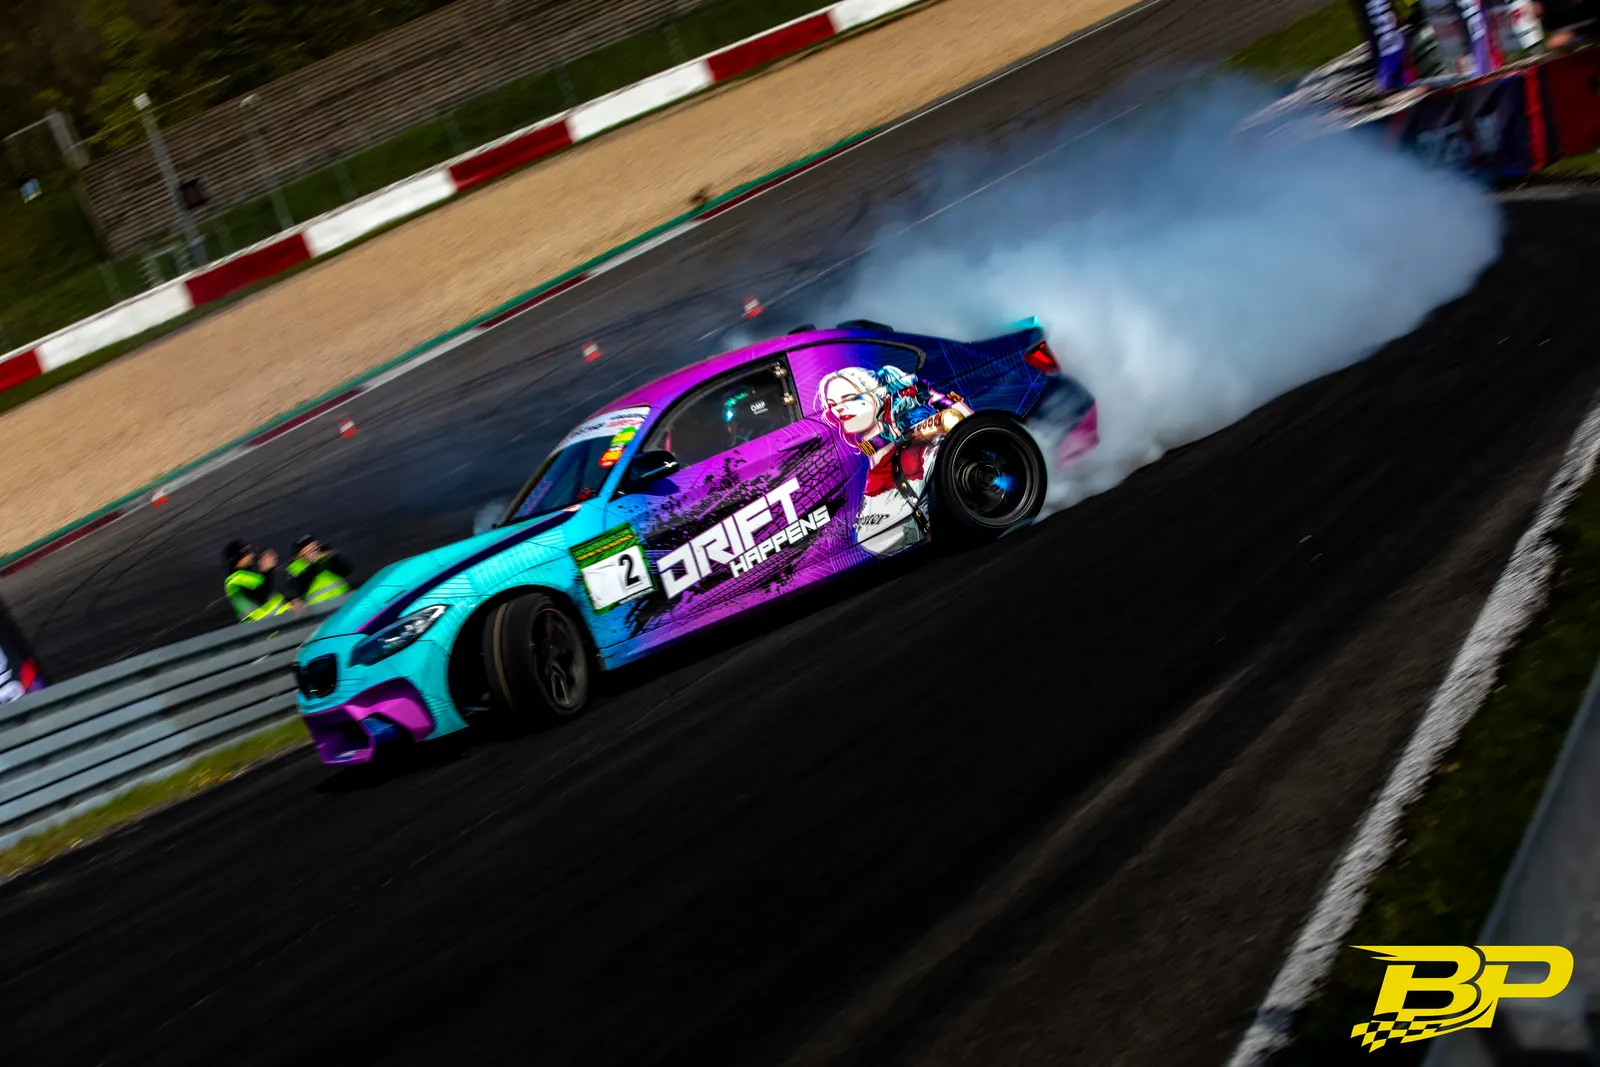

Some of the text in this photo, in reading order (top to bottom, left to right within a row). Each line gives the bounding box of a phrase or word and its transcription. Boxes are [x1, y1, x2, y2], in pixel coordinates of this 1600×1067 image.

[618, 553, 640, 587] 2
[656, 477, 801, 600] DRIFT
[729, 504, 831, 578] HAPPENS
